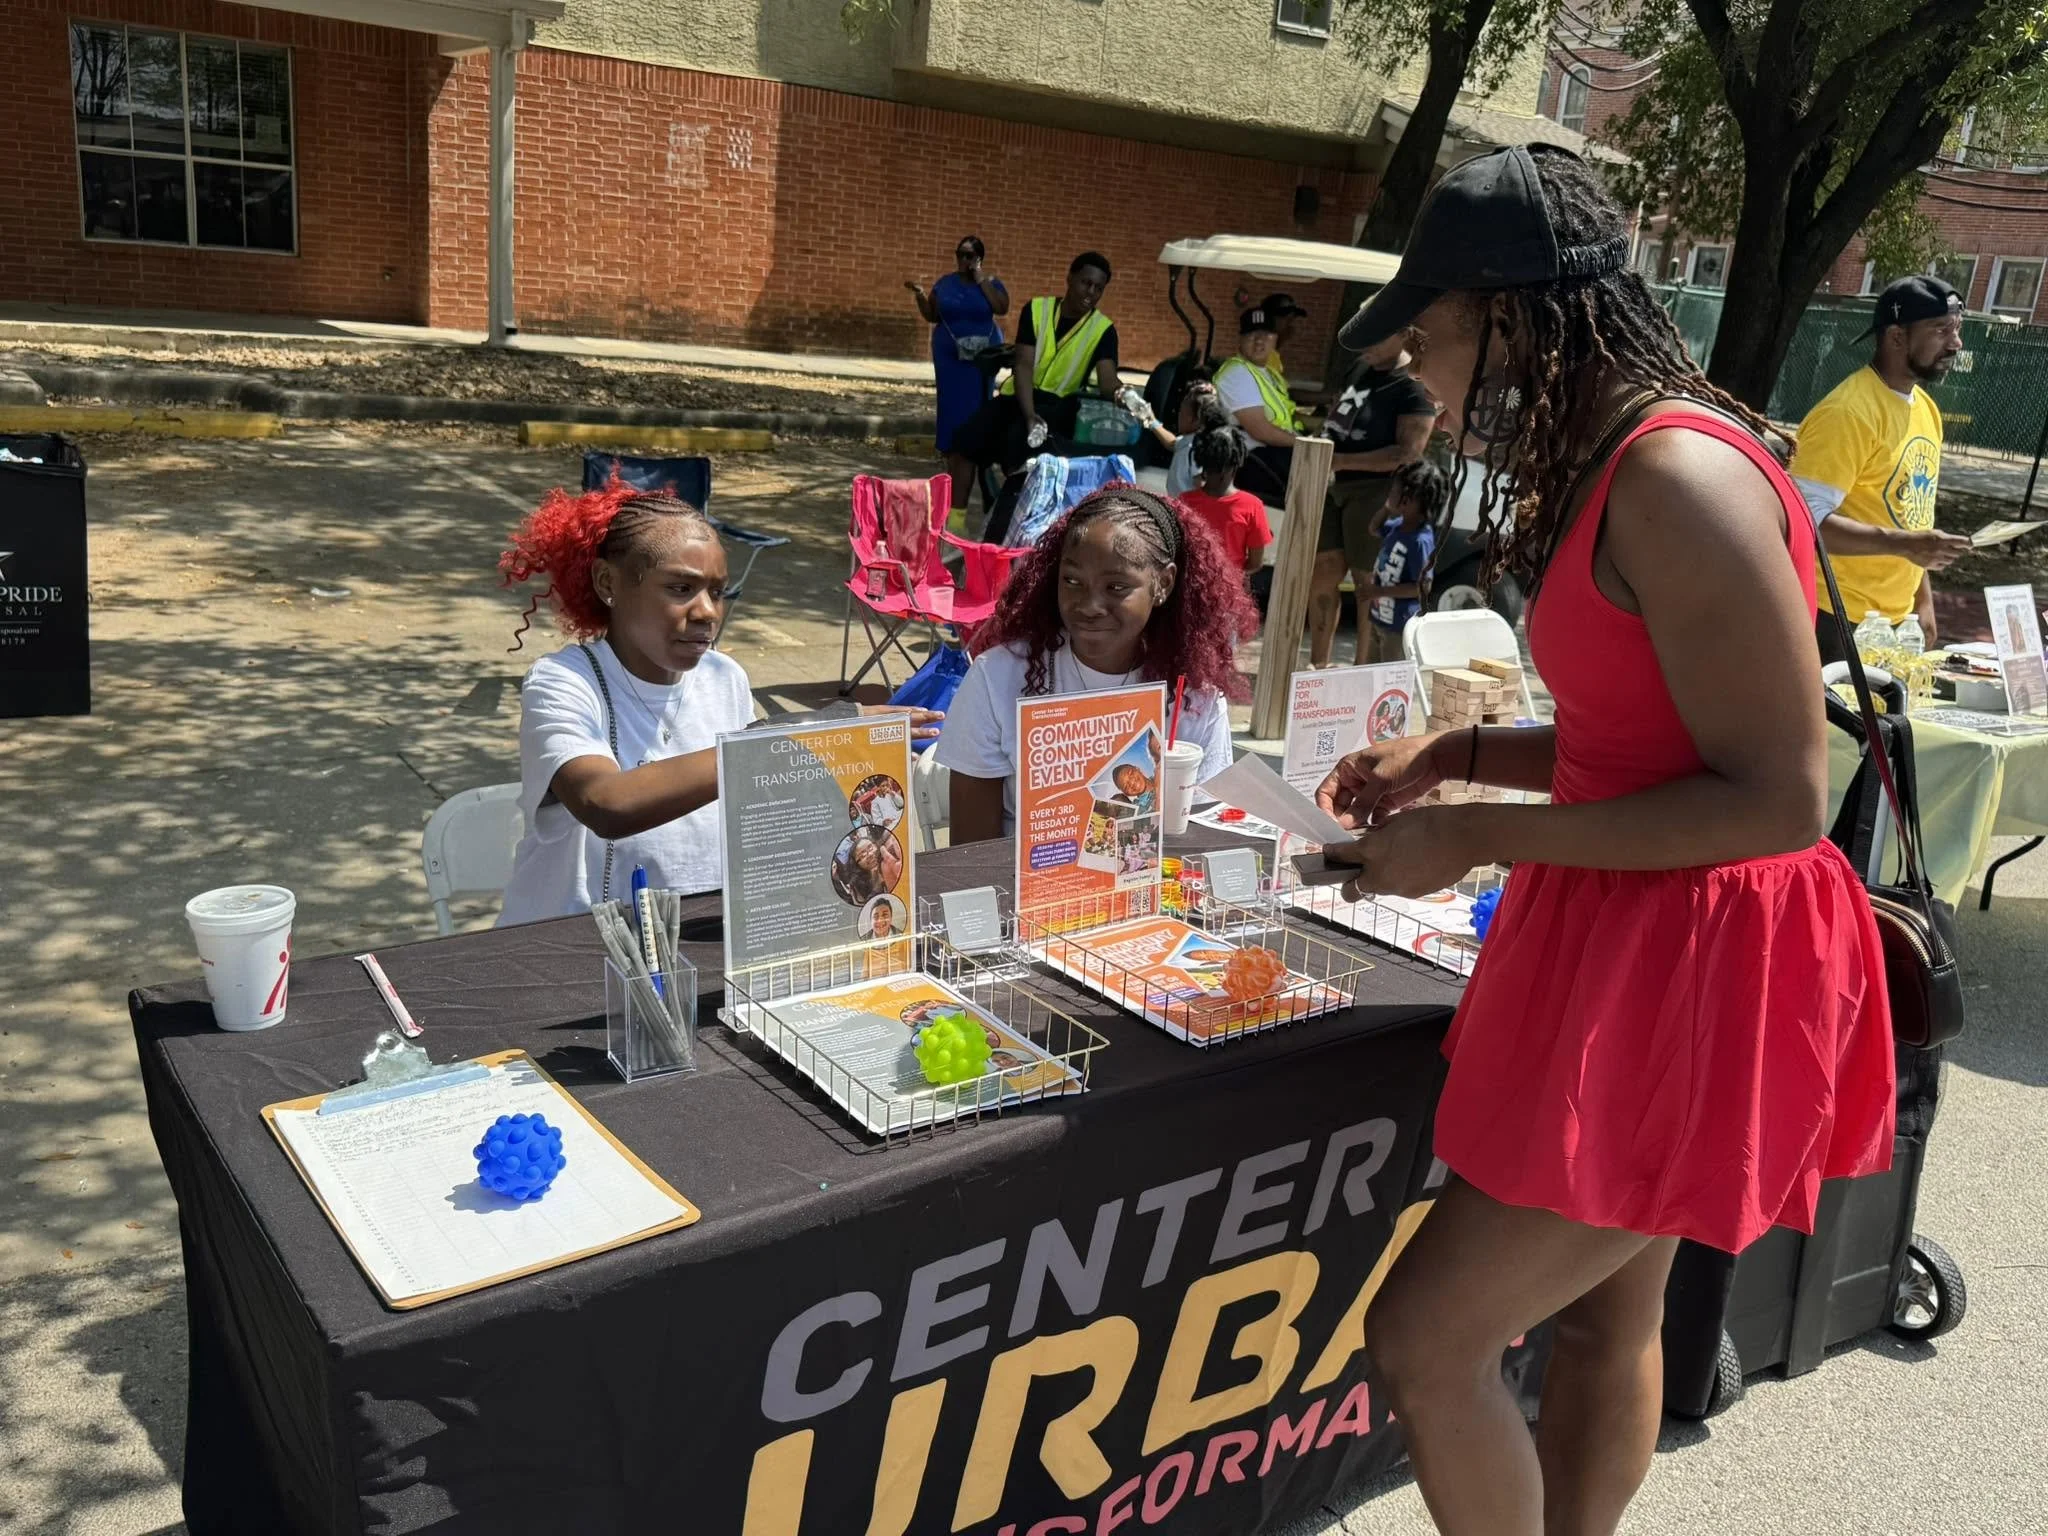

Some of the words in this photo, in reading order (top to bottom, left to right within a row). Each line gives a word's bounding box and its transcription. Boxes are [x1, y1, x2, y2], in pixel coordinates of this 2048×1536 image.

[1295, 679, 1325, 690] CENTER
[1295, 690, 1310, 699] FOR
[1292, 705, 1356, 720] TRANSFORMATION
[1293, 700, 1319, 711] URBAN
[1028, 709, 1138, 749] COMMUNITY
[770, 735, 823, 754] CENTER
[826, 732, 853, 747] FOR
[789, 752, 836, 767] URBAN
[1029, 735, 1114, 768] CONNECT
[752, 760, 875, 788] TRANSFORMATION
[1029, 760, 1087, 790] EVENT
[1030, 807, 1056, 820] EVERY
[1058, 804, 1075, 815] 3RD
[1030, 817, 1068, 832] TUESDAY
[1070, 815, 1080, 824] OF
[1030, 832, 1046, 843] THE
[1047, 827, 1078, 840] MONTH
[643, 921, 654, 965] CENTER
[791, 996, 844, 1012] CENTER
[760, 1116, 1398, 1423] CENTER
